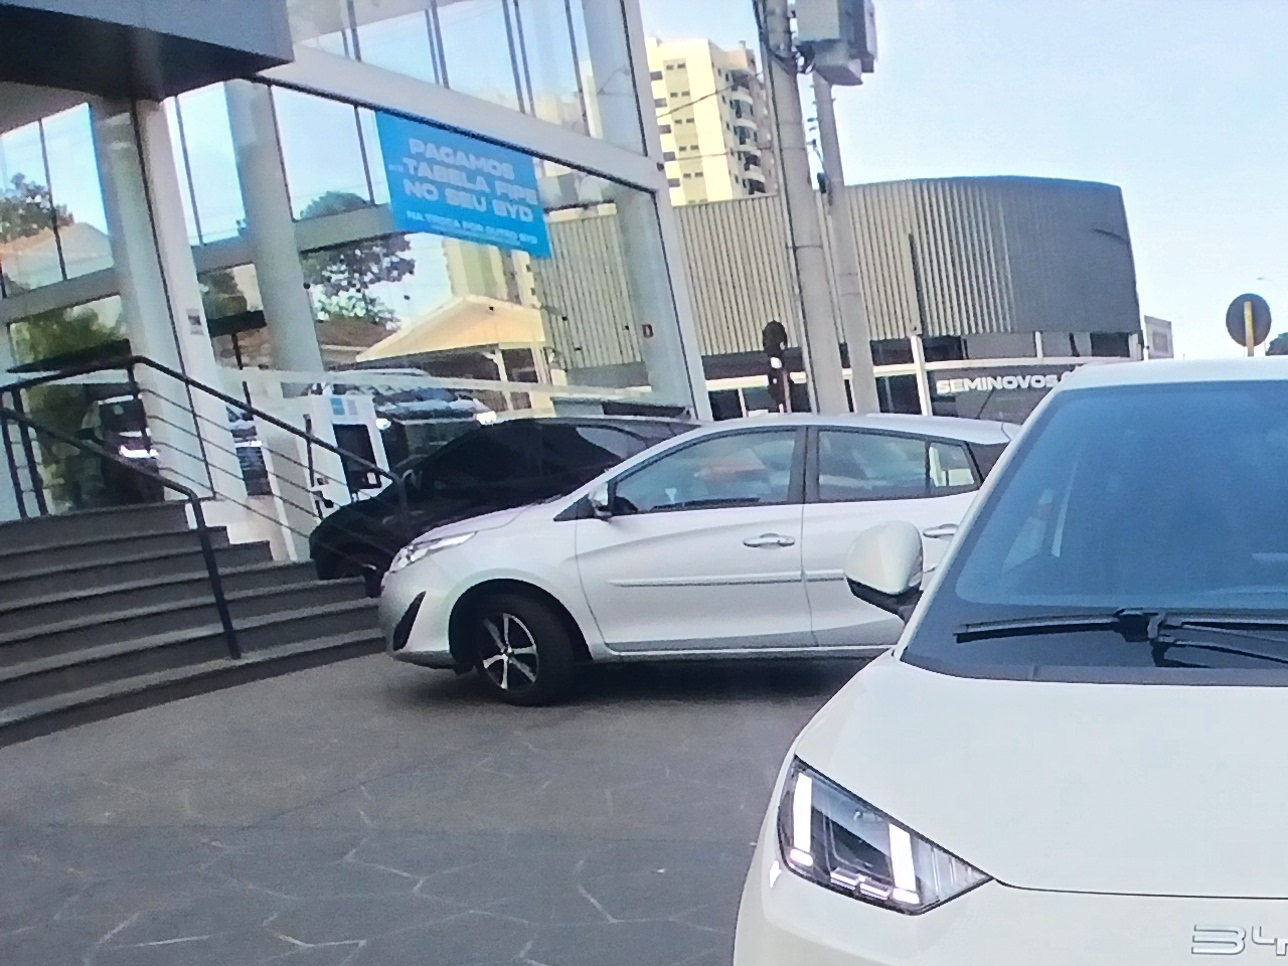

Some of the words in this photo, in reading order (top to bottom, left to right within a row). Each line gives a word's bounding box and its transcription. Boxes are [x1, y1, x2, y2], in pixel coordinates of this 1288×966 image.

[408, 138, 515, 180] PAGAMOS
[403, 178, 439, 201] NO
[936, 374, 1058, 395] SEMINOVOS
